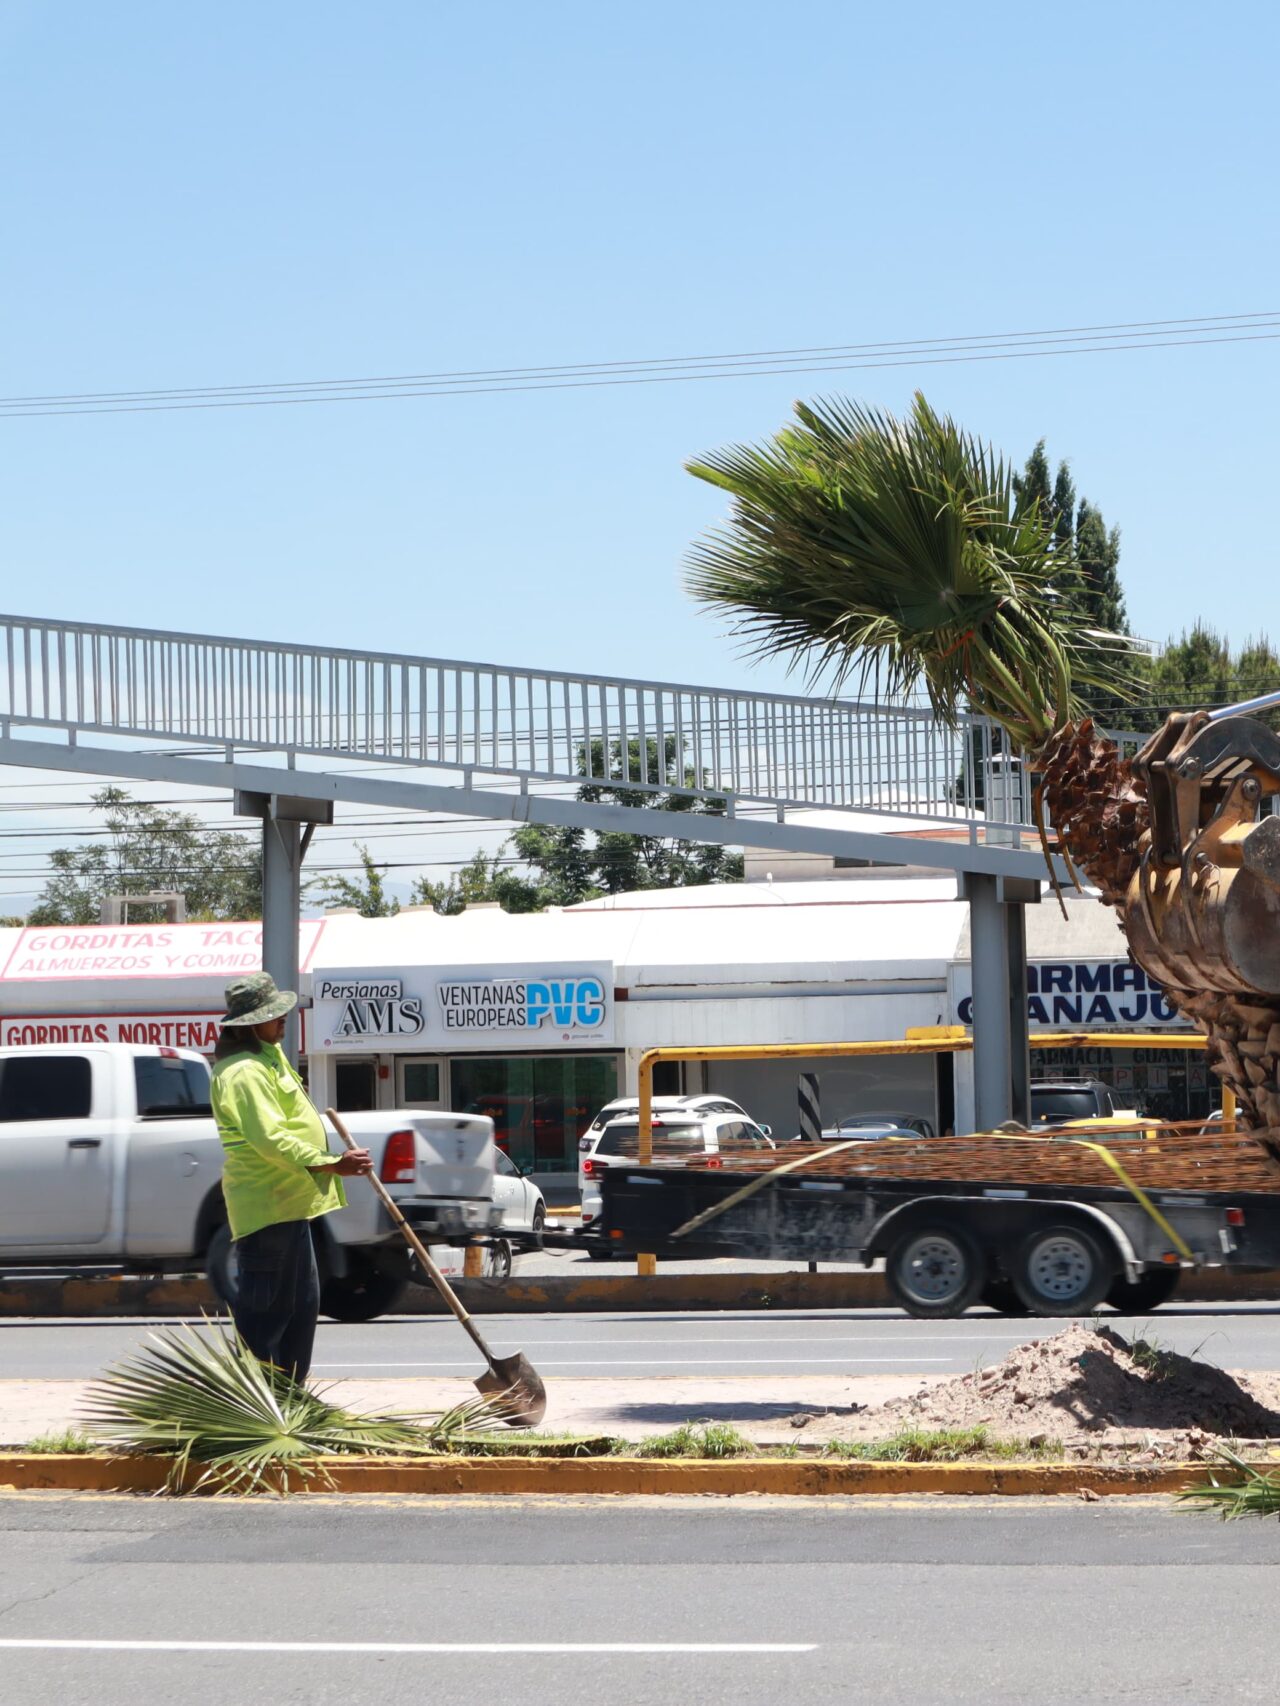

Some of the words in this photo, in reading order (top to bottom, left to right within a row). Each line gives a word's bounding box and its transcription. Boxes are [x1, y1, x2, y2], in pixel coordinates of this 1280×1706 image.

[28, 932, 172, 951] GORDITAS
[200, 930, 262, 947] TAC
[18, 956, 151, 972] ALMUERZOS
[166, 955, 181, 968] Y
[321, 981, 398, 999] Persianas
[440, 984, 525, 1006] VENTANAS
[526, 982, 601, 1026] PVC
[334, 999, 424, 1035] AMS
[446, 1008, 526, 1027] EUROPEAS
[7, 1024, 109, 1046] GORDITAS
[118, 1021, 224, 1047] NORTEÑA
